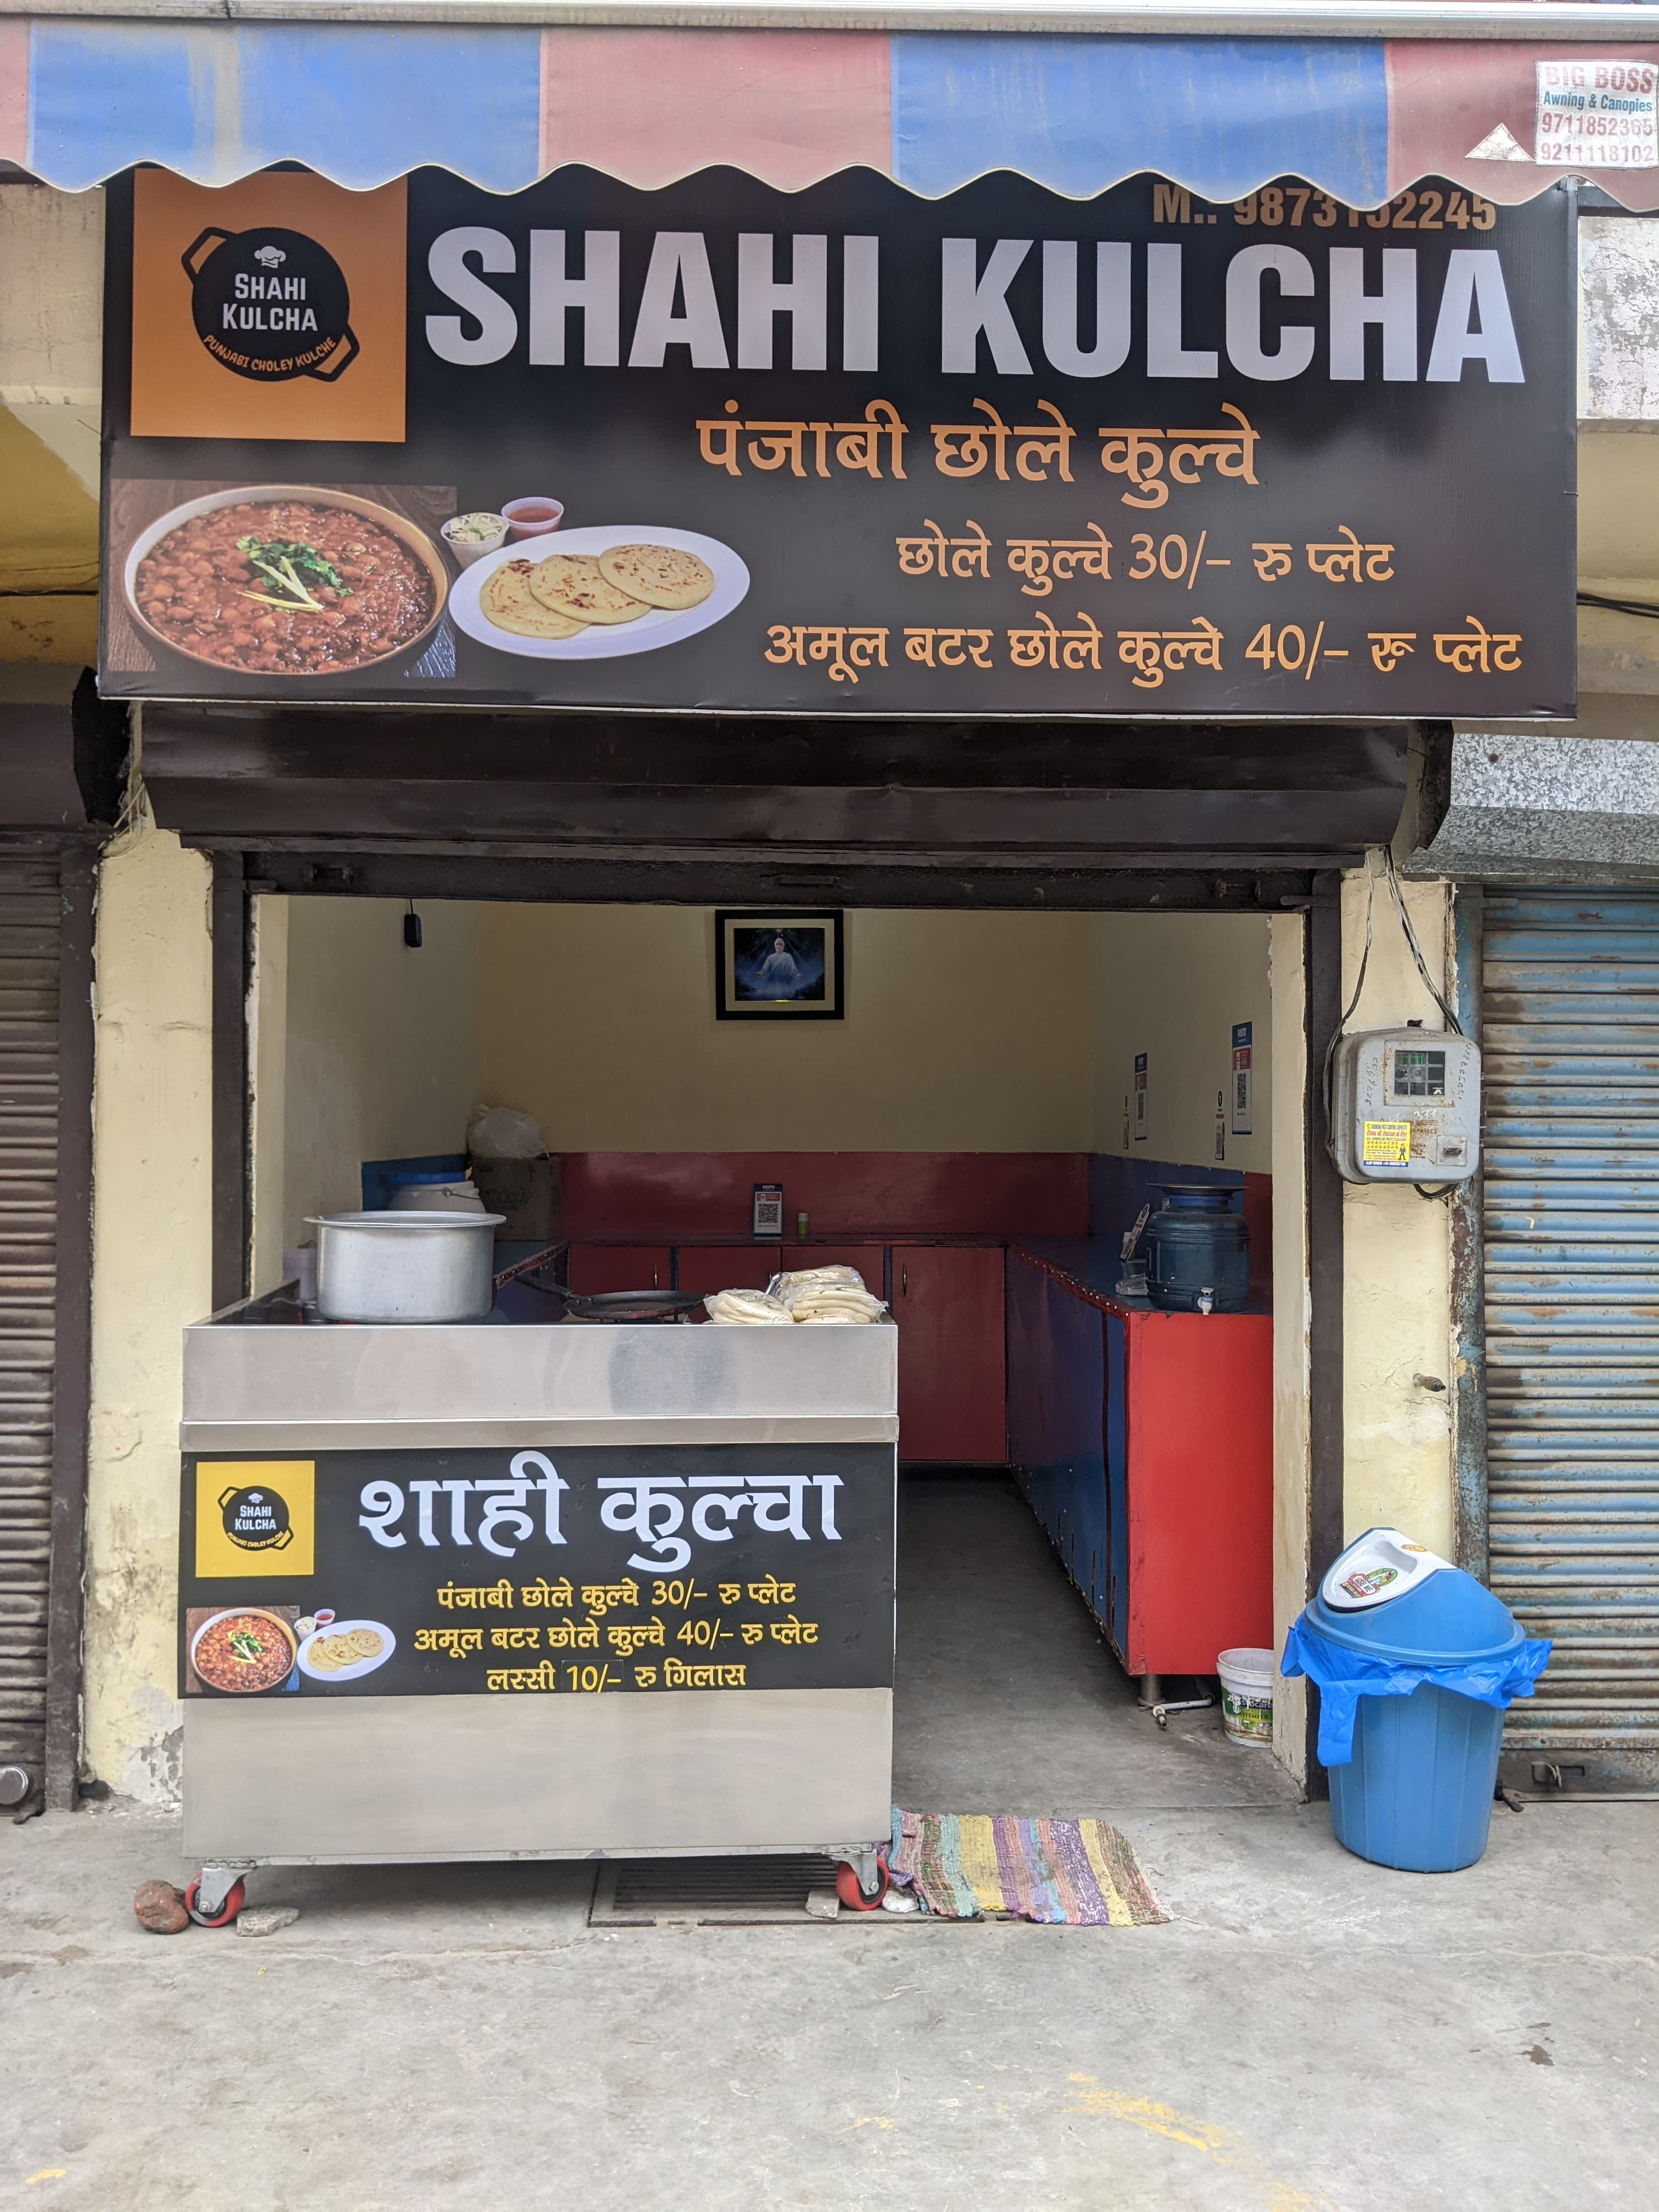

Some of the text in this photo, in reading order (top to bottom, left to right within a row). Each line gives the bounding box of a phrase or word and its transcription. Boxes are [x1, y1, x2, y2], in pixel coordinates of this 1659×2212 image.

[1545, 66, 1654, 94] BIG BOSS
[1543, 91, 1653, 114] Awning & Canopies
[235, 274, 305, 300] SHAHI
[426, 227, 1526, 383] SHAHI KULCHA
[223, 303, 317, 331] KULCHA
[204, 335, 336, 371] PUNJABI CHOLEY KULCHE
[696, 398, 1260, 509] पंजाबी छोले कुल्चे
[896, 519, 1395, 596] छोले कुल्चे 30/- रु प्लेट
[764, 625, 890, 684] अमूल
[904, 628, 994, 668] बटर
[1008, 611, 1103, 669] छोले
[1118, 617, 1224, 687] कुल्चे
[1245, 621, 1348, 680] 40/-
[1434, 616, 1522, 673] प्लेट
[234, 1518, 277, 1531] KULCHA
[240, 1505, 272, 1517] SHAHI
[359, 1450, 844, 1572] शाही कुल्चा
[437, 1574, 796, 1615] पंजाबी छोले कुल्चे 30/- रु प्लेट
[1355, 1578, 1367, 1587] USE
[1363, 1583, 1374, 1593] ME
[414, 1614, 818, 1658] अमूल बटर छोले कुल्चे 40/- रु प्लेट
[487, 1658, 746, 1694] लस्सी 10/- रु गिलास
